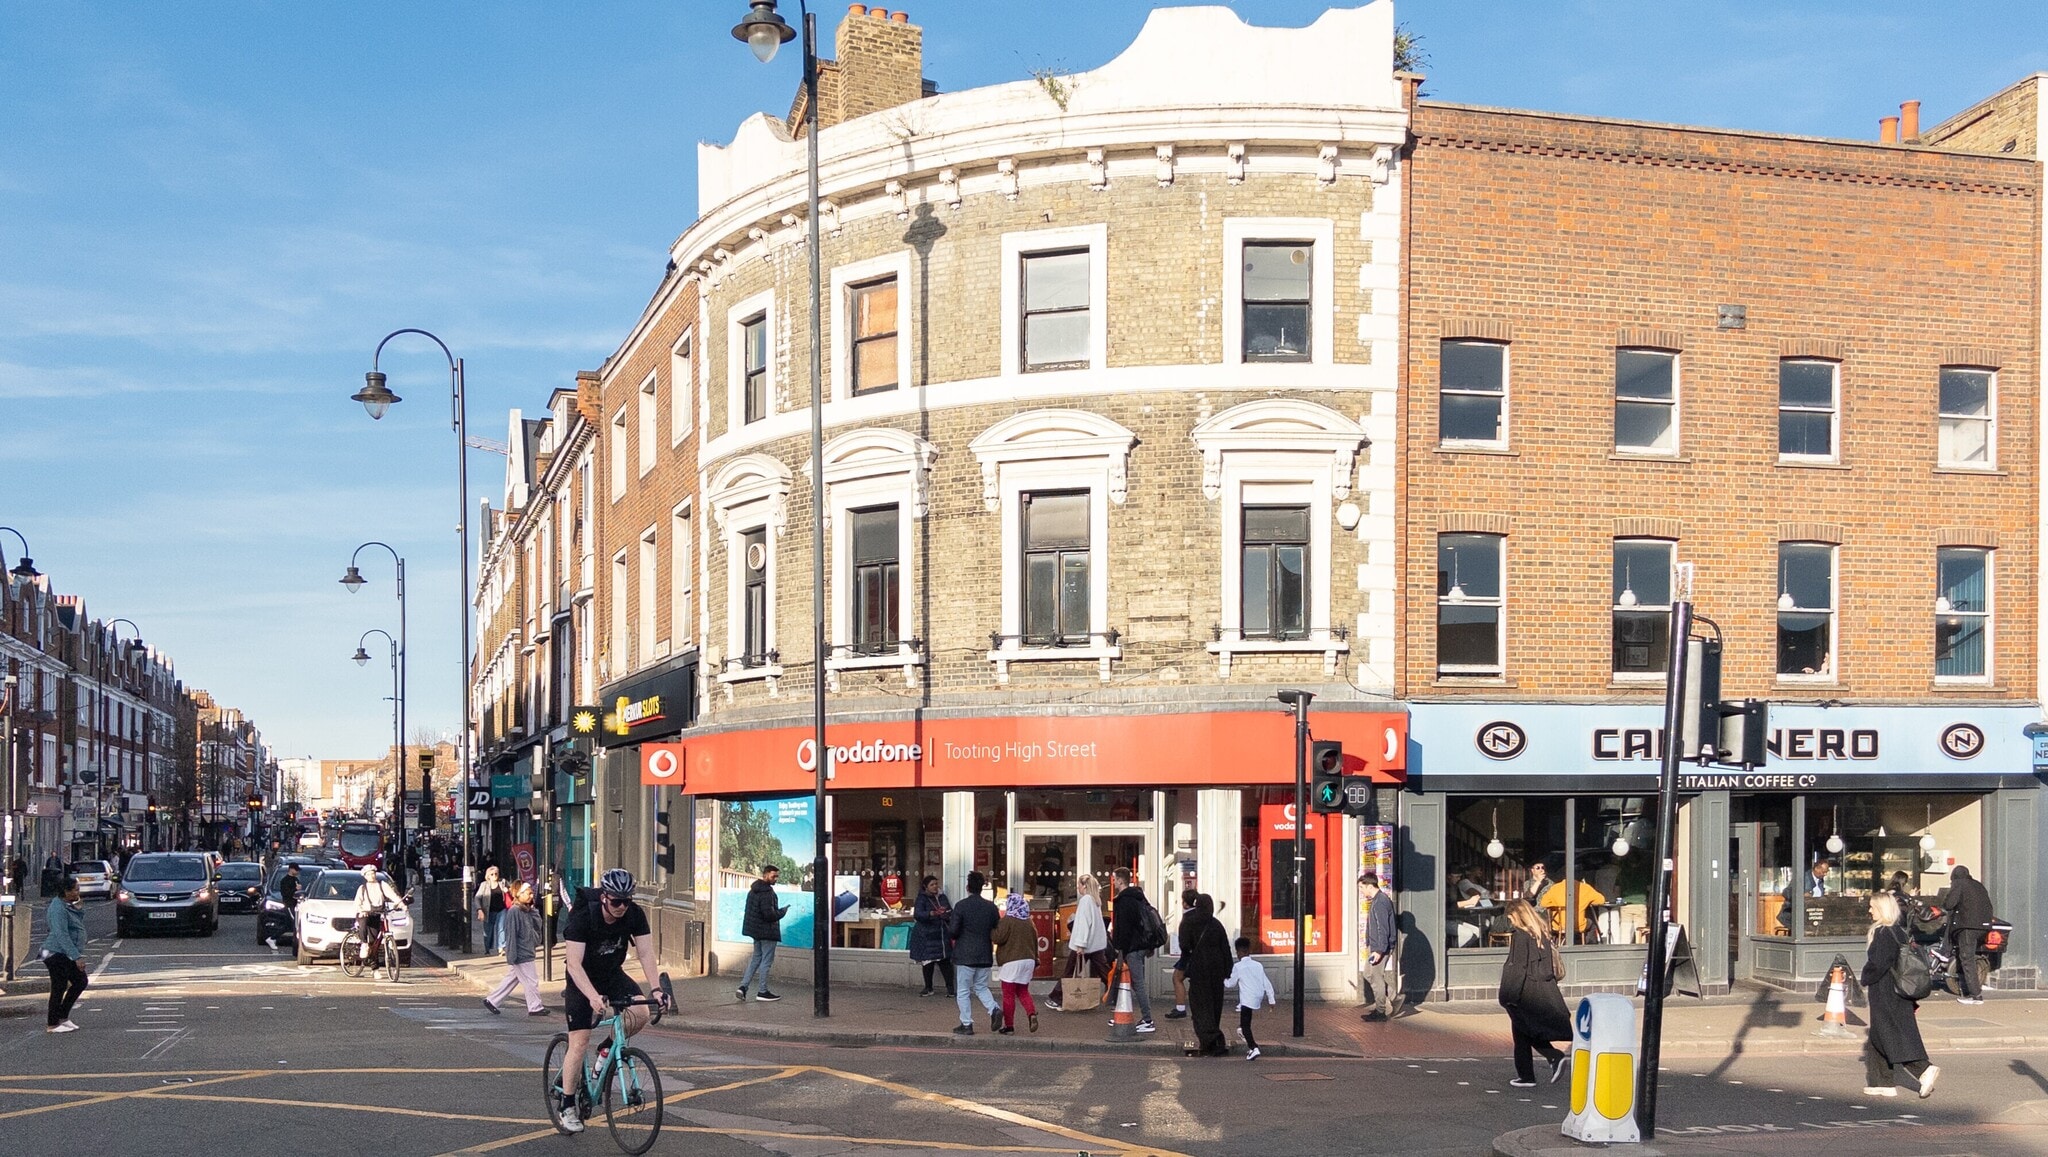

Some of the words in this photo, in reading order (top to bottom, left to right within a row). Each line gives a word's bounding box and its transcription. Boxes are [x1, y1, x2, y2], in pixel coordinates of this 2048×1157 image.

[642, 695, 660, 718] SLOTS
[828, 739, 923, 763] odafone
[944, 742, 1001, 763] Tooting
[1005, 741, 1042, 763] High
[1047, 740, 1097, 758] Street
[1656, 776, 1682, 788] TE
[1686, 776, 1739, 788] ITALIAN
[1744, 775, 1794, 788] COFFEE
[469, 791, 490, 806] JD
[1273, 822, 1313, 831] vodae
[1267, 931, 1282, 939] This
[1799, 1119, 1924, 1130] LEFT
